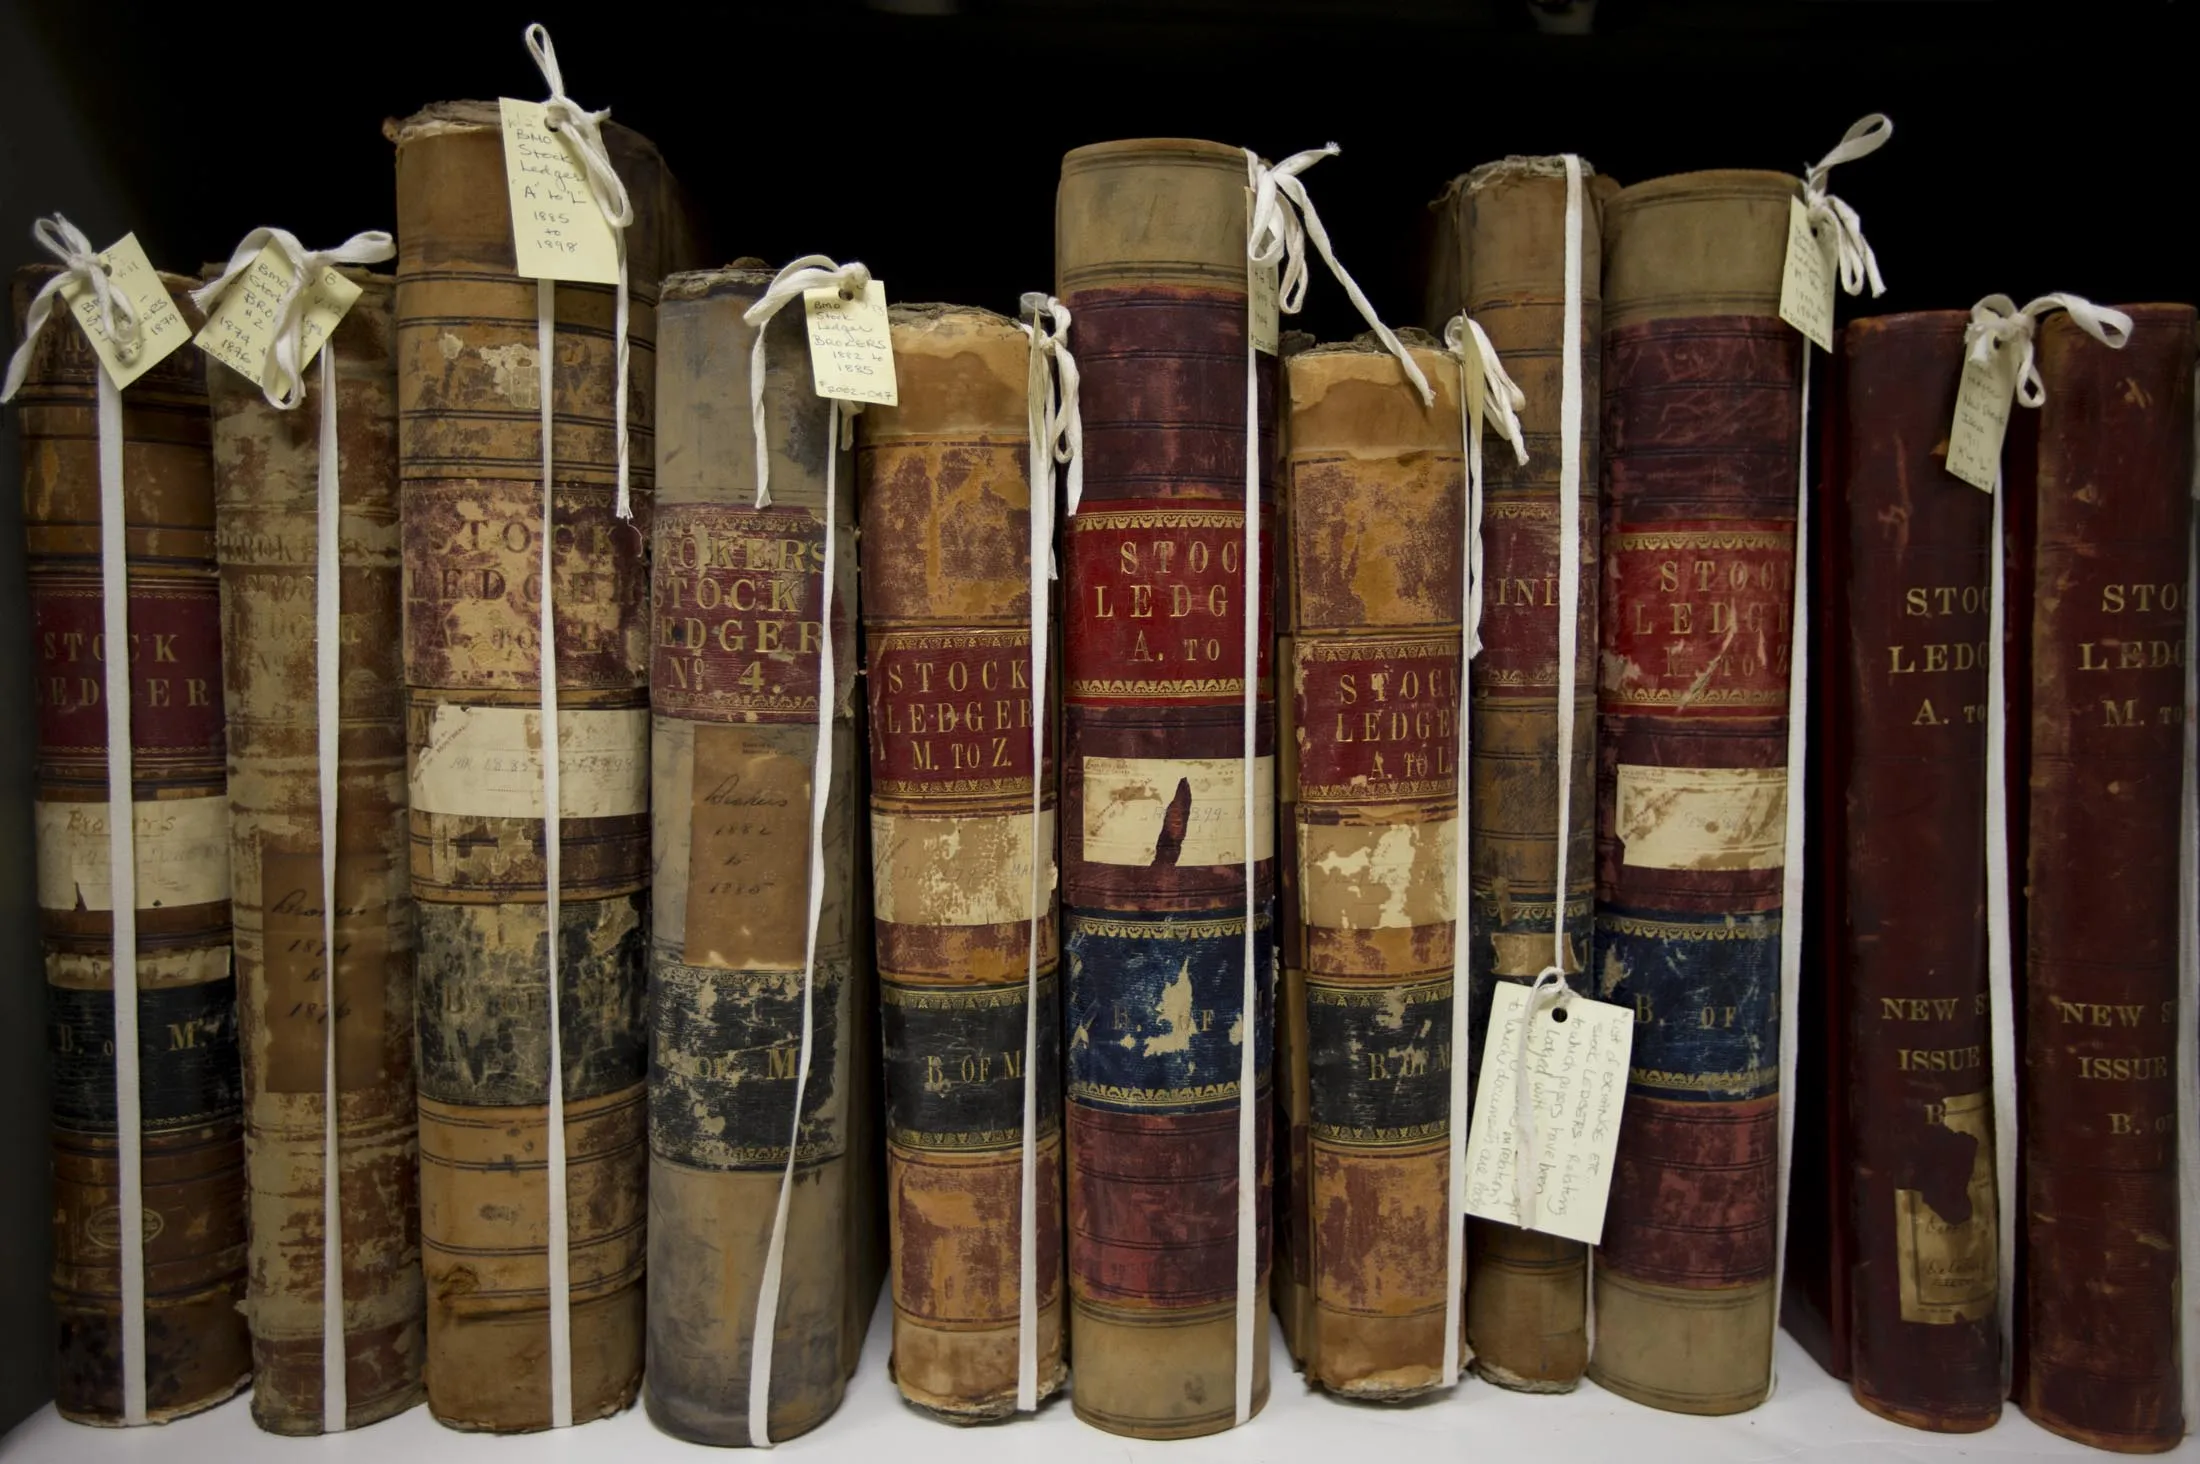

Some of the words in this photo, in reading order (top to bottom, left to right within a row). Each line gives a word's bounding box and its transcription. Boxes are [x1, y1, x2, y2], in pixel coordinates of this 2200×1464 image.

[1119, 540, 1239, 575] STOC
[653, 576, 801, 612] STOCK
[1095, 584, 1229, 619] LEDG
[1906, 585, 1990, 616] STOC
[1184, 637, 1221, 662] TO
[888, 659, 1029, 693] STOCK
[887, 699, 1033, 734] LEDGER
[952, 743, 980, 769] TO
[1404, 751, 1428, 777] TO
[1699, 1004, 1738, 1030] OF
[1880, 996, 1959, 1021] NEW
[2061, 1002, 2144, 1028] NEW
[961, 1054, 992, 1083] OF
[1897, 1045, 1980, 1072] ISSUE
[2078, 1055, 2168, 1081] ISSUE
[2106, 1113, 2142, 1135] B.
